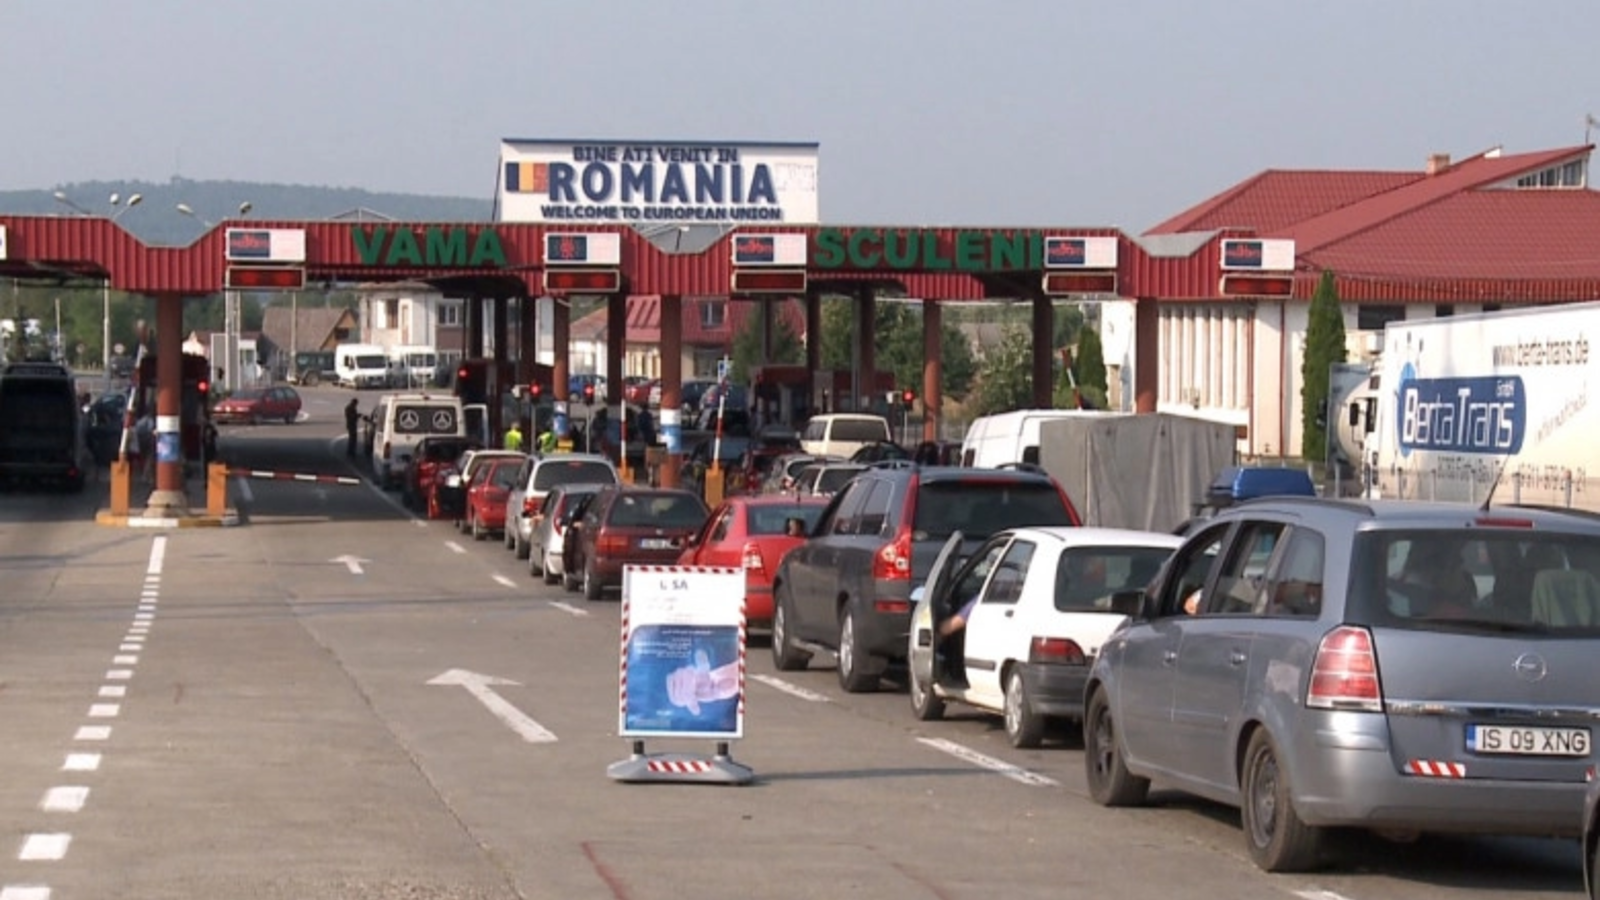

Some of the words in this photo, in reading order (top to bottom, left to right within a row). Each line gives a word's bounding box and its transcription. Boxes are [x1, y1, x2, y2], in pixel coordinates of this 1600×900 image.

[573, 146, 616, 162] BINE
[658, 147, 713, 163] VENIT
[717, 148, 738, 163] IN
[549, 161, 777, 204] ROMANIA
[541, 205, 618, 220] WELCOME
[621, 206, 641, 220] TO
[644, 206, 727, 220] EUROPEAN
[730, 207, 781, 221] UNION
[352, 226, 506, 266] VAMA
[813, 228, 1044, 270] SCULENI
[1482, 729, 1502, 749] IS
[1510, 730, 1534, 751] 09
[1542, 731, 1586, 752] XNG
